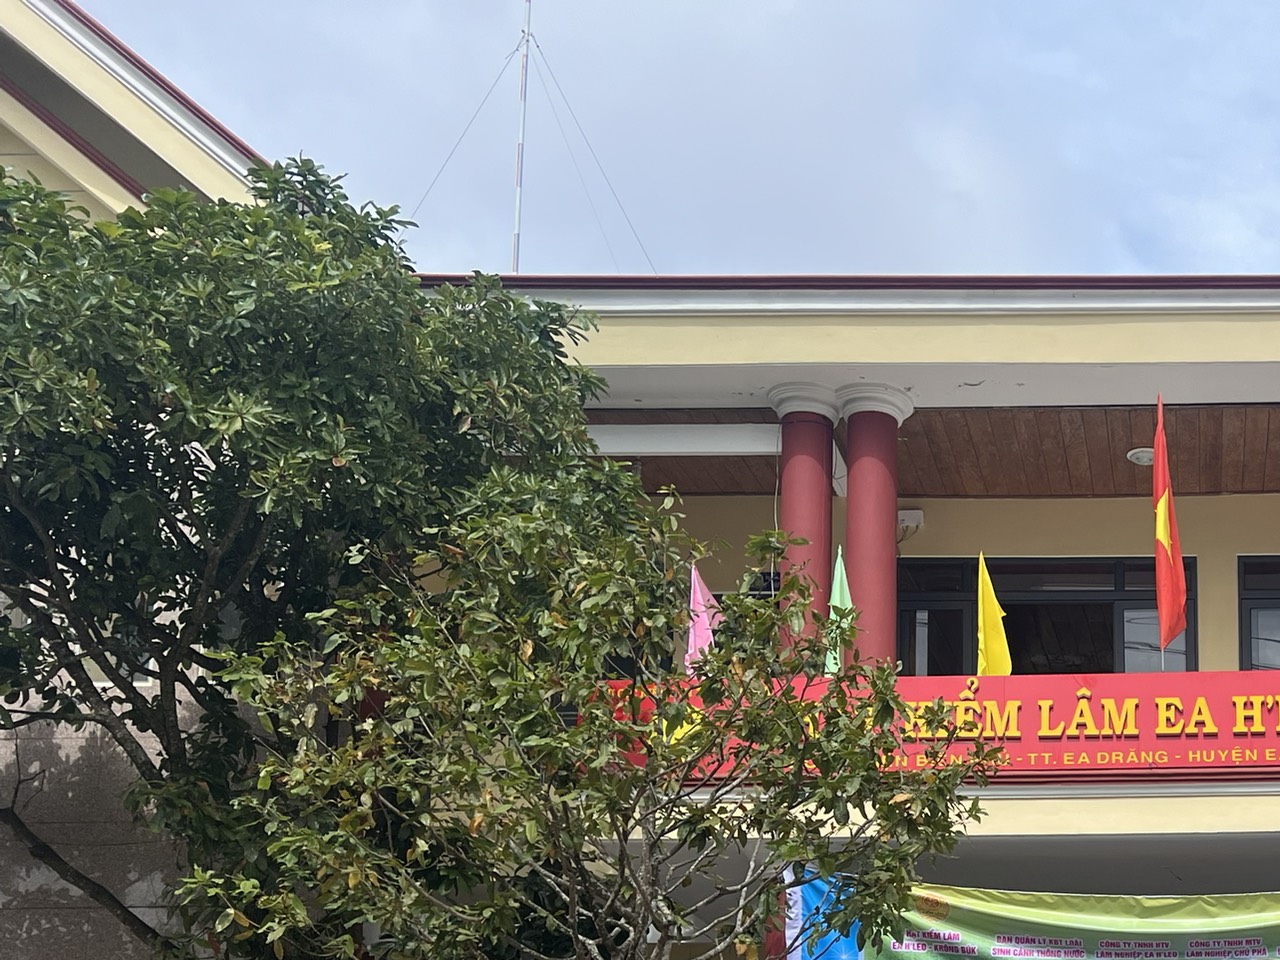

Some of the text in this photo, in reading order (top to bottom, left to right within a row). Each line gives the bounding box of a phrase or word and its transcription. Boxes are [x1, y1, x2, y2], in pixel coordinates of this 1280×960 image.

[1038, 687, 1139, 738] LÂM
[1155, 697, 1218, 737] EA
[1027, 753, 1057, 765] TT.
[1063, 752, 1090, 764] EA
[1097, 748, 1168, 764] DRĂNG
[1188, 746, 1257, 765] HUYỆN
[943, 930, 960, 941] LÂM
[996, 935, 1013, 944] BAN
[1122, 941, 1132, 949] TY
[1189, 940, 1211, 948] CÔNG
[1245, 938, 1261, 946] MTV
[992, 947, 1011, 956] SINH
[1036, 948, 1062, 958] THÔNG
